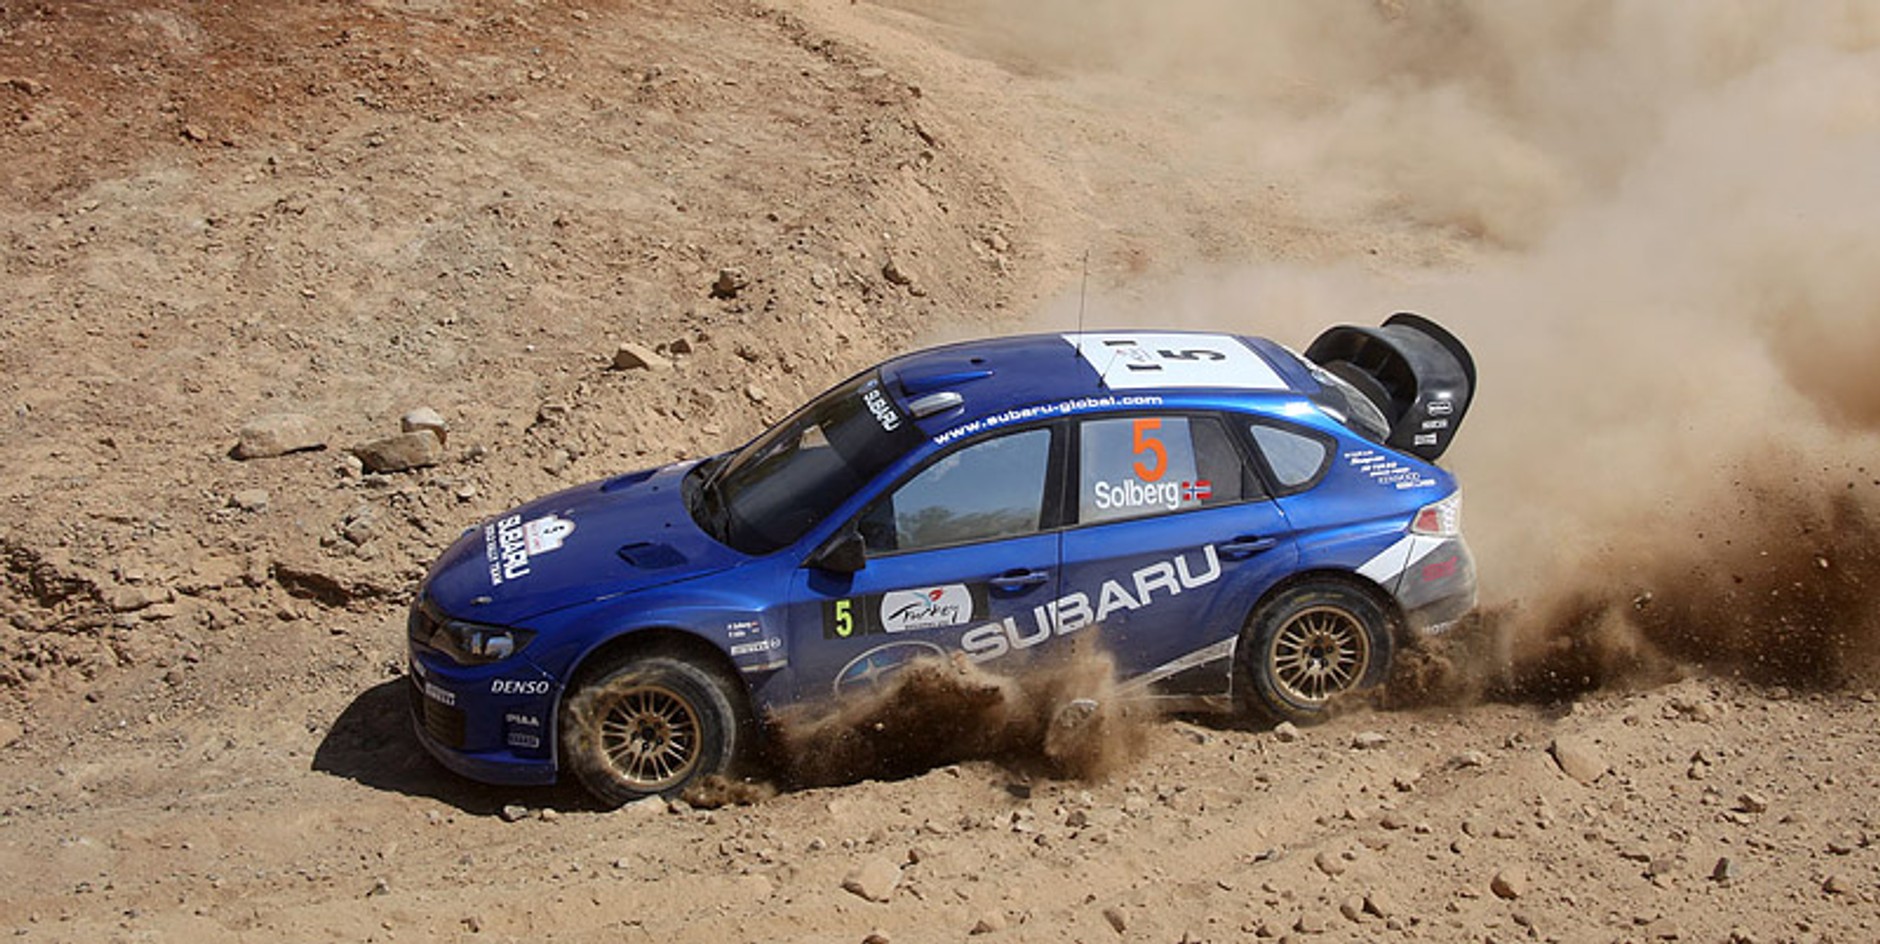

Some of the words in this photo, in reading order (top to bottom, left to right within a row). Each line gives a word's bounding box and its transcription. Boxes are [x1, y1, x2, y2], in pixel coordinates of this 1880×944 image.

[1157, 349, 1226, 361] 5
[863, 390, 901, 431] SUBARU
[933, 394, 1164, 446] www.subaru-global.com
[1132, 417, 1168, 483] 5
[1094, 479, 1179, 510] Solberg
[498, 513, 530, 579] SUBARU
[835, 600, 852, 637] 5
[960, 544, 1221, 664] SUBARU
[491, 680, 549, 695] DENSO
